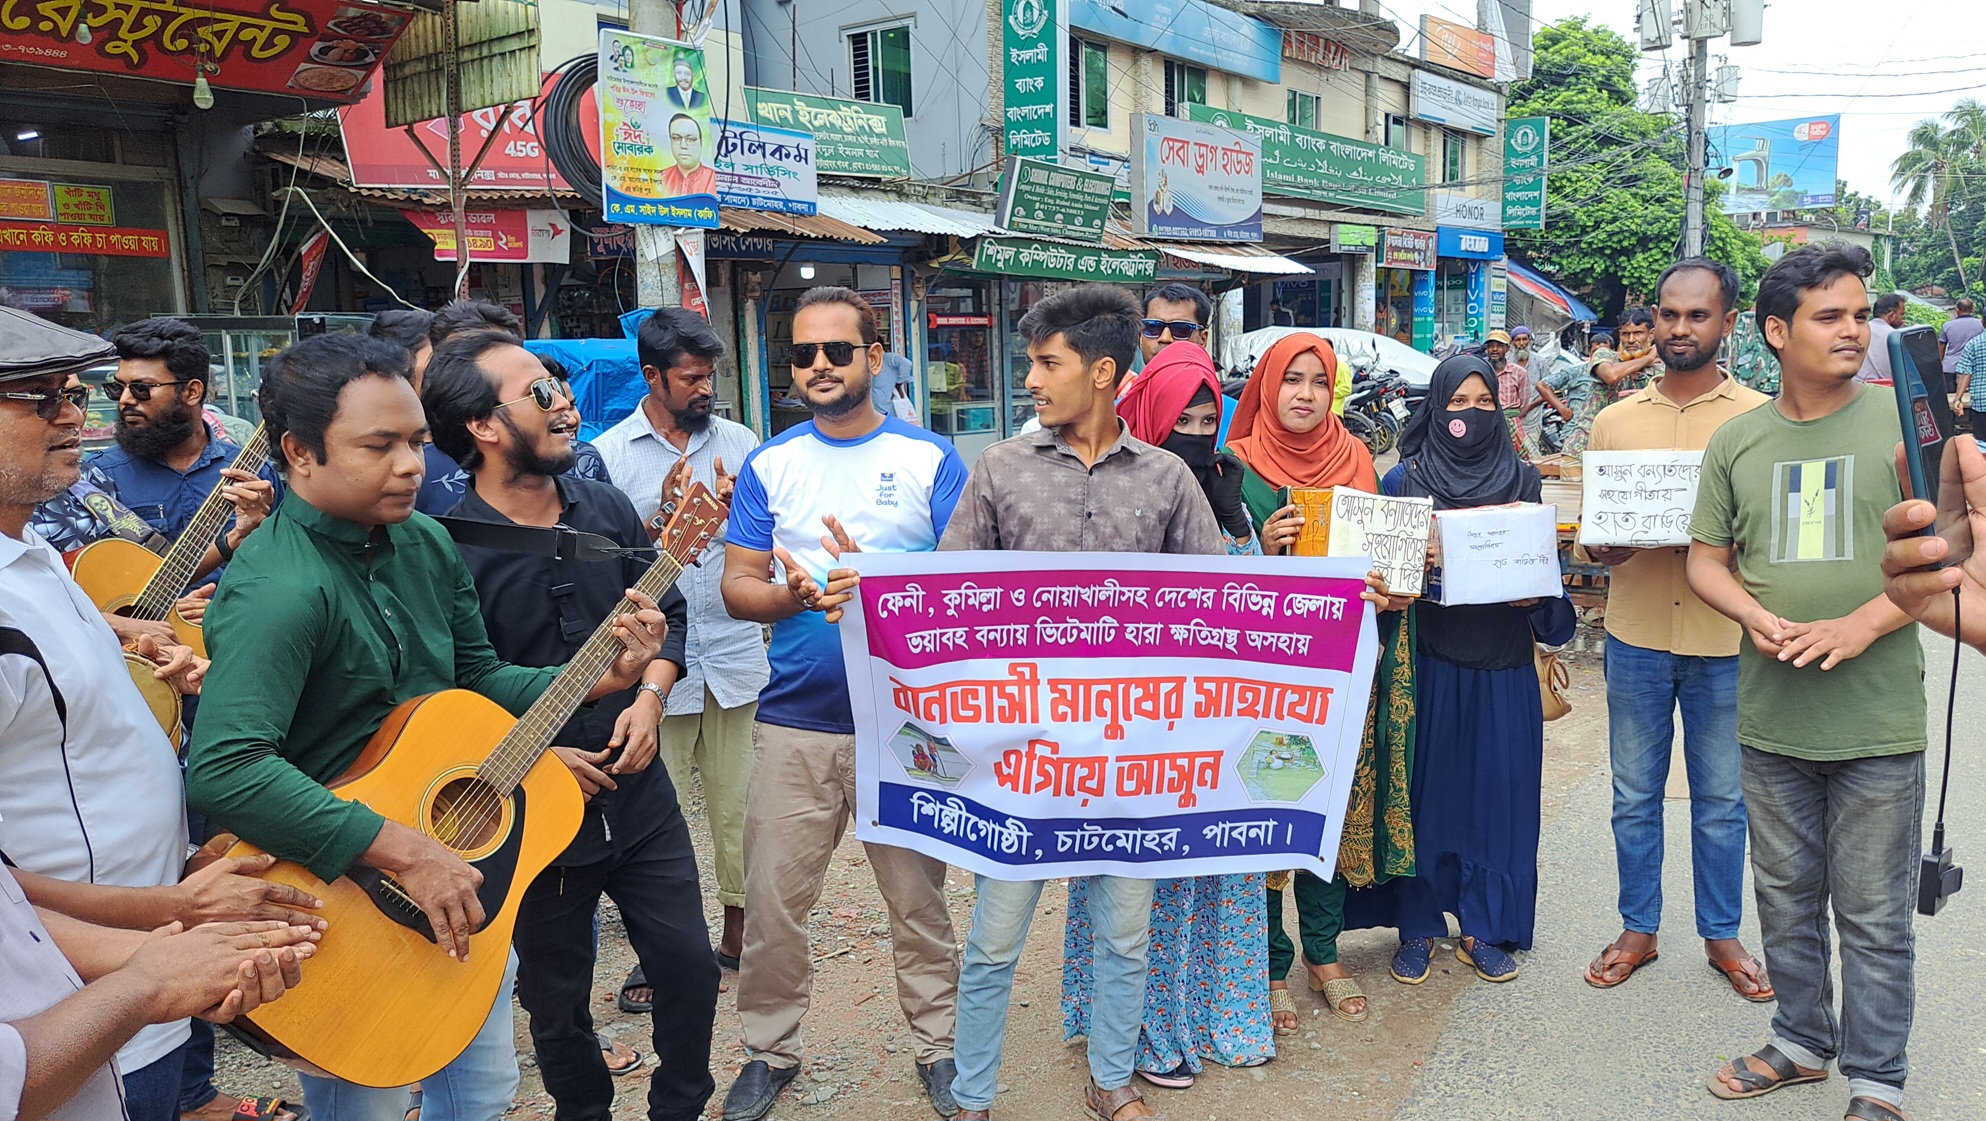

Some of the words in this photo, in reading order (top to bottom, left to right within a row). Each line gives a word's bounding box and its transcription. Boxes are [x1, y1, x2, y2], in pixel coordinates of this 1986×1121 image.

[1009, 43, 1049, 66] ইসলামী
[1014, 76, 1045, 94] ব্যাংক
[757, 100, 794, 124] খান
[1006, 103, 1054, 123] বাংলাদেশ
[613, 141, 654, 156] মোবারক
[1008, 129, 1052, 149] লিমিটেড
[1160, 136, 1191, 168] সেবা
[1220, 140, 1255, 178] হাউজ
[1295, 132, 1327, 154] ব্যাংক
[1329, 139, 1376, 165] বাংলাদেশ
[1378, 147, 1417, 173] লিমিটেড
[1076, 178, 1084, 191] &
[1266, 169, 1295, 182] Islami
[1455, 203, 1485, 221] HONOR
[29, 225, 55, 247] কফি
[57, 232, 68, 247] ও
[69, 227, 93, 249] কফি
[95, 232, 107, 249] চা
[110, 233, 139, 252] পাওয়া
[982, 238, 1017, 271] শিমুল
[1019, 243, 1077, 272] কম্পিউটার
[1595, 464, 1636, 484] আসুন
[876, 499, 899, 508] Baby
[1336, 495, 1378, 531] আসুন
[1592, 511, 1639, 536] হাত
[878, 583, 935, 618] ফেনী,
[941, 582, 1004, 618] কুমিল্লা
[1010, 588, 1026, 607] ও
[1033, 578, 1151, 609] নোয়াখালীসহ
[1155, 586, 1217, 610] দেশের
[1221, 582, 1279, 620] বিভিন্ন
[1283, 592, 1347, 622] জেলায়
[905, 627, 969, 654] ভয়াবহ
[973, 623, 1030, 648] বন্যায়
[1034, 616, 1119, 646] ভিটেমাটি
[1124, 622, 1164, 647] হারা
[1245, 629, 1313, 656] অসহায়
[1047, 676, 1187, 741] মানুষের
[993, 739, 1109, 807] এগিয়ে
[1115, 749, 1224, 808] আসুন
[1054, 822, 1190, 857] চাটমোহর,
